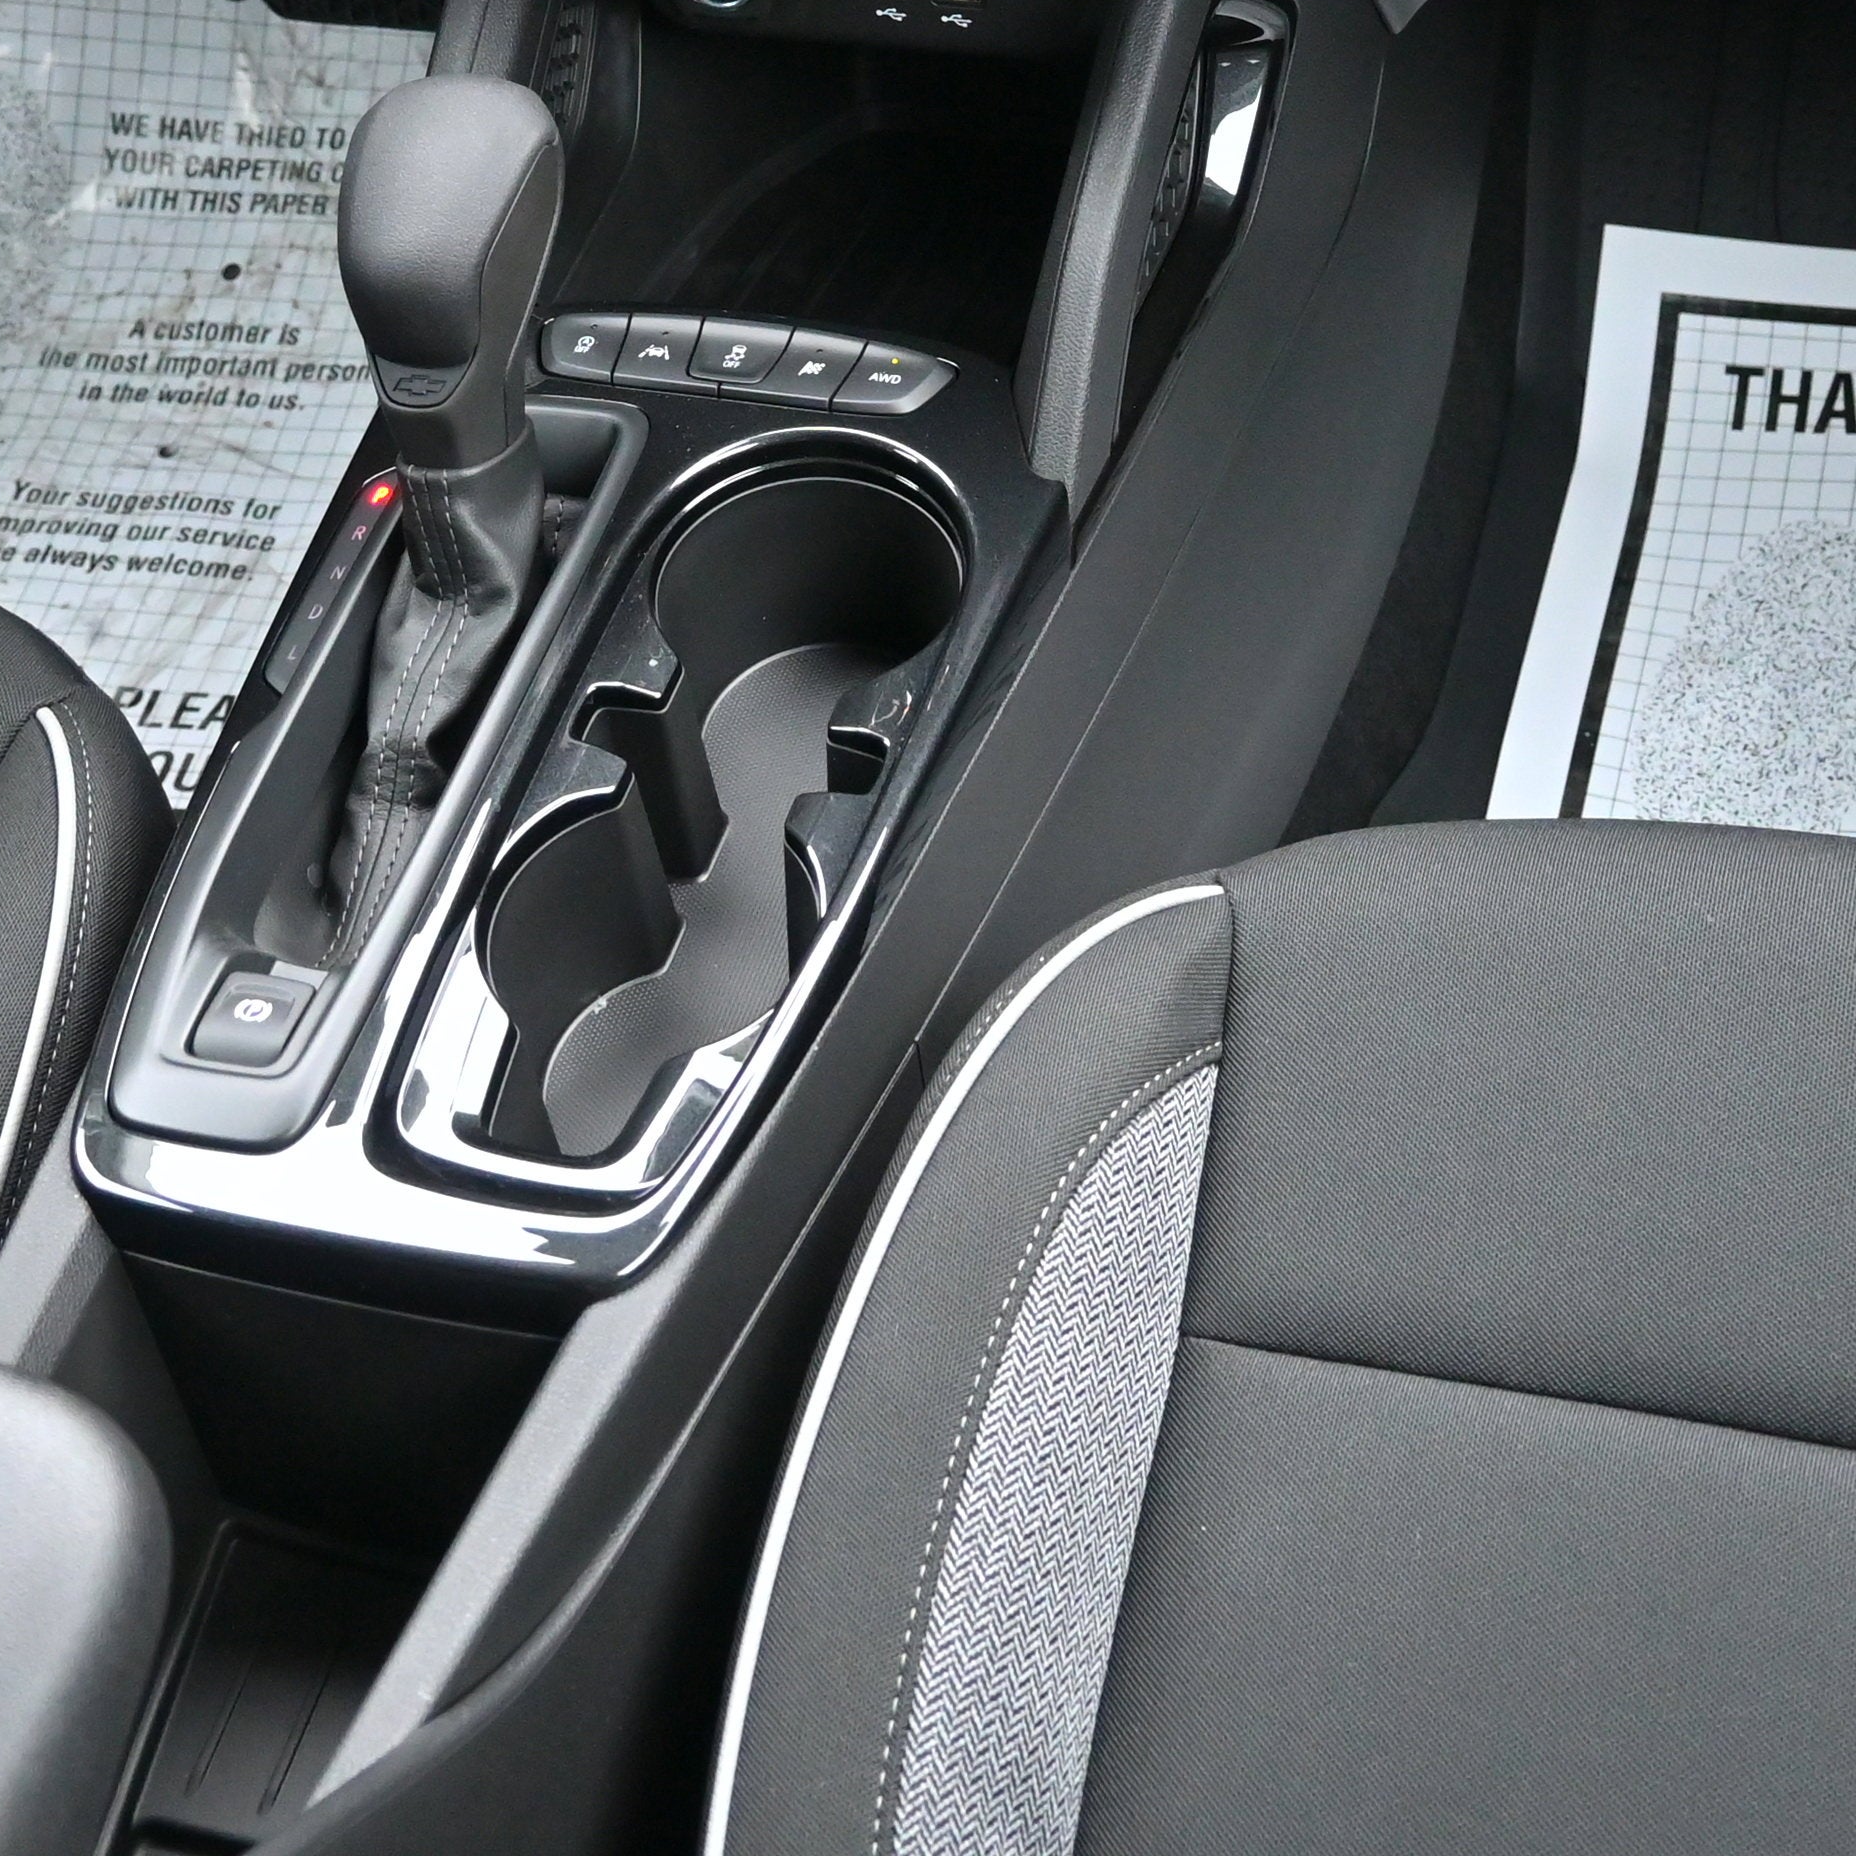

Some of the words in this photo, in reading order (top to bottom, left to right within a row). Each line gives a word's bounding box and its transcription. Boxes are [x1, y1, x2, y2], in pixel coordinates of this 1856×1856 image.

[111, 112, 149, 137] WE
[159, 116, 225, 144] HAVE
[234, 122, 305, 148] TRIED
[317, 127, 345, 151] TO
[104, 147, 176, 176] YOUR
[184, 155, 322, 183] CARPETING
[115, 187, 179, 210] WITH
[186, 190, 242, 213] THIS
[249, 193, 330, 215] PAPER
[128, 319, 145, 339] A
[153, 320, 271, 343] customer
[279, 323, 299, 344] is
[38, 346, 82, 367] the
[84, 351, 148, 373] most
[156, 351, 279, 379] important
[284, 363, 371, 382] person
[723, 360, 740, 369] OFF
[868, 371, 902, 385] AWD
[78, 381, 101, 400] in
[111, 383, 146, 403] the
[157, 384, 226, 407] world
[236, 389, 260, 408] to
[268, 395, 305, 411] us.
[12, 479, 69, 505] Your
[75, 489, 233, 516] suggestions
[243, 498, 282, 521] for
[127, 523, 170, 541] our
[177, 526, 276, 553] service
[351, 525, 366, 541] R
[24, 544, 119, 574] always
[125, 552, 254, 582] welcome.
[330, 566, 346, 580] N
[308, 604, 323, 620] D
[288, 645, 297, 660] L
[113, 686, 235, 730] PLEA
